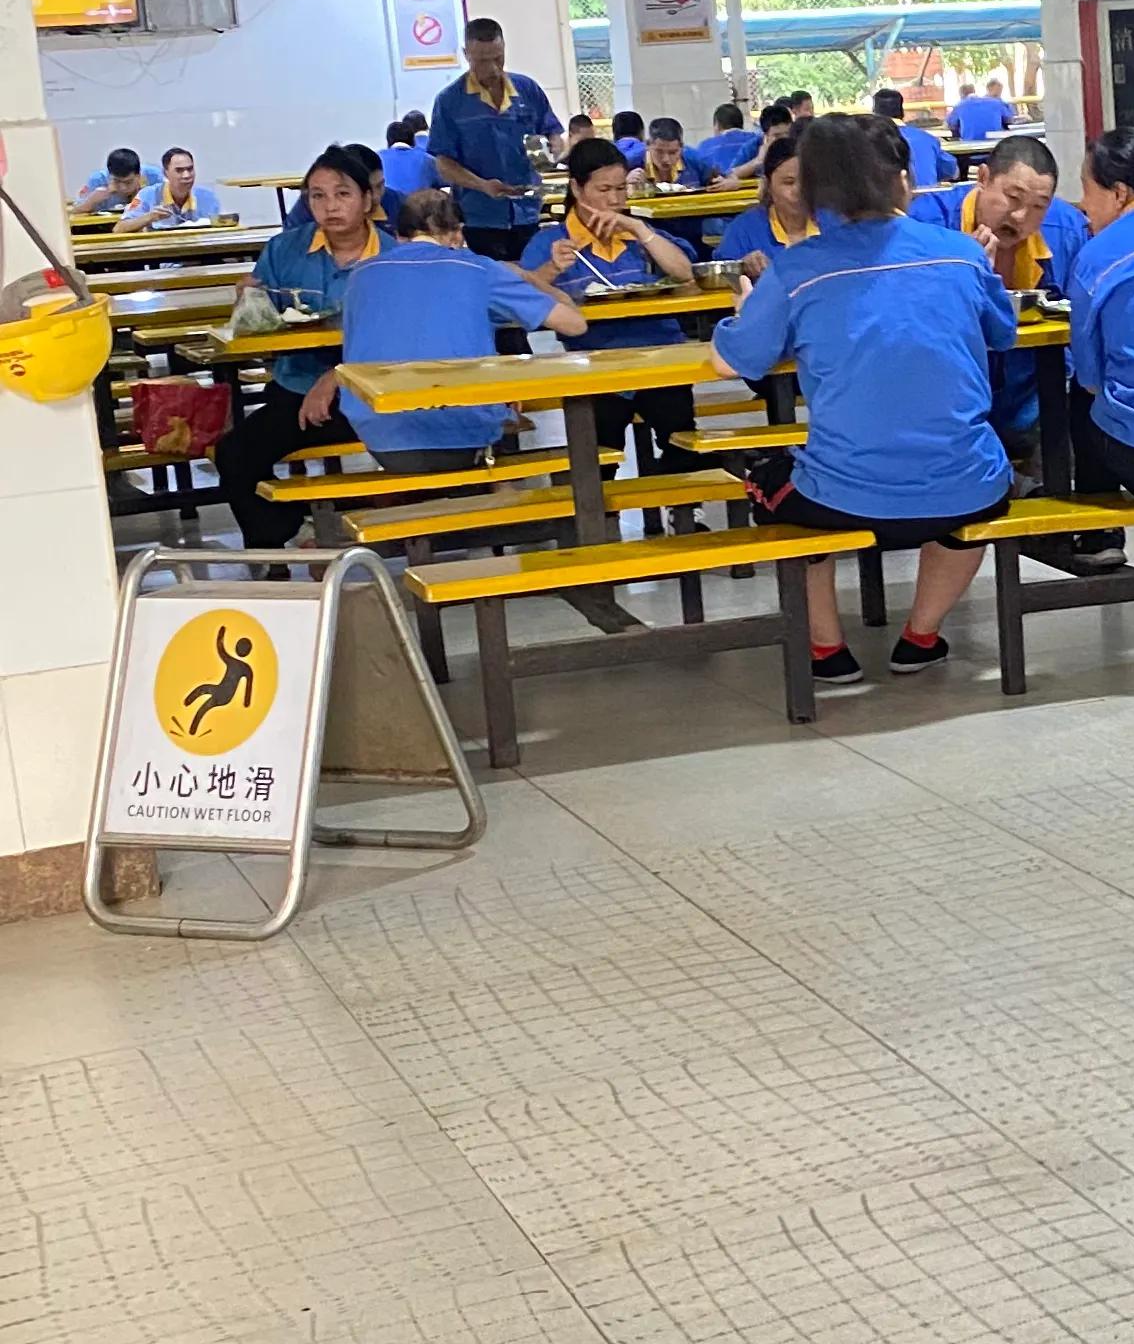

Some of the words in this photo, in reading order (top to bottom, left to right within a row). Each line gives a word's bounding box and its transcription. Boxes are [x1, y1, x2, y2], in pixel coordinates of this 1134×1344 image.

[132, 761, 275, 801] 小心地滑
[127, 805, 190, 820] CAUTION
[193, 807, 224, 821] WET
[226, 808, 272, 823] FLOOR
